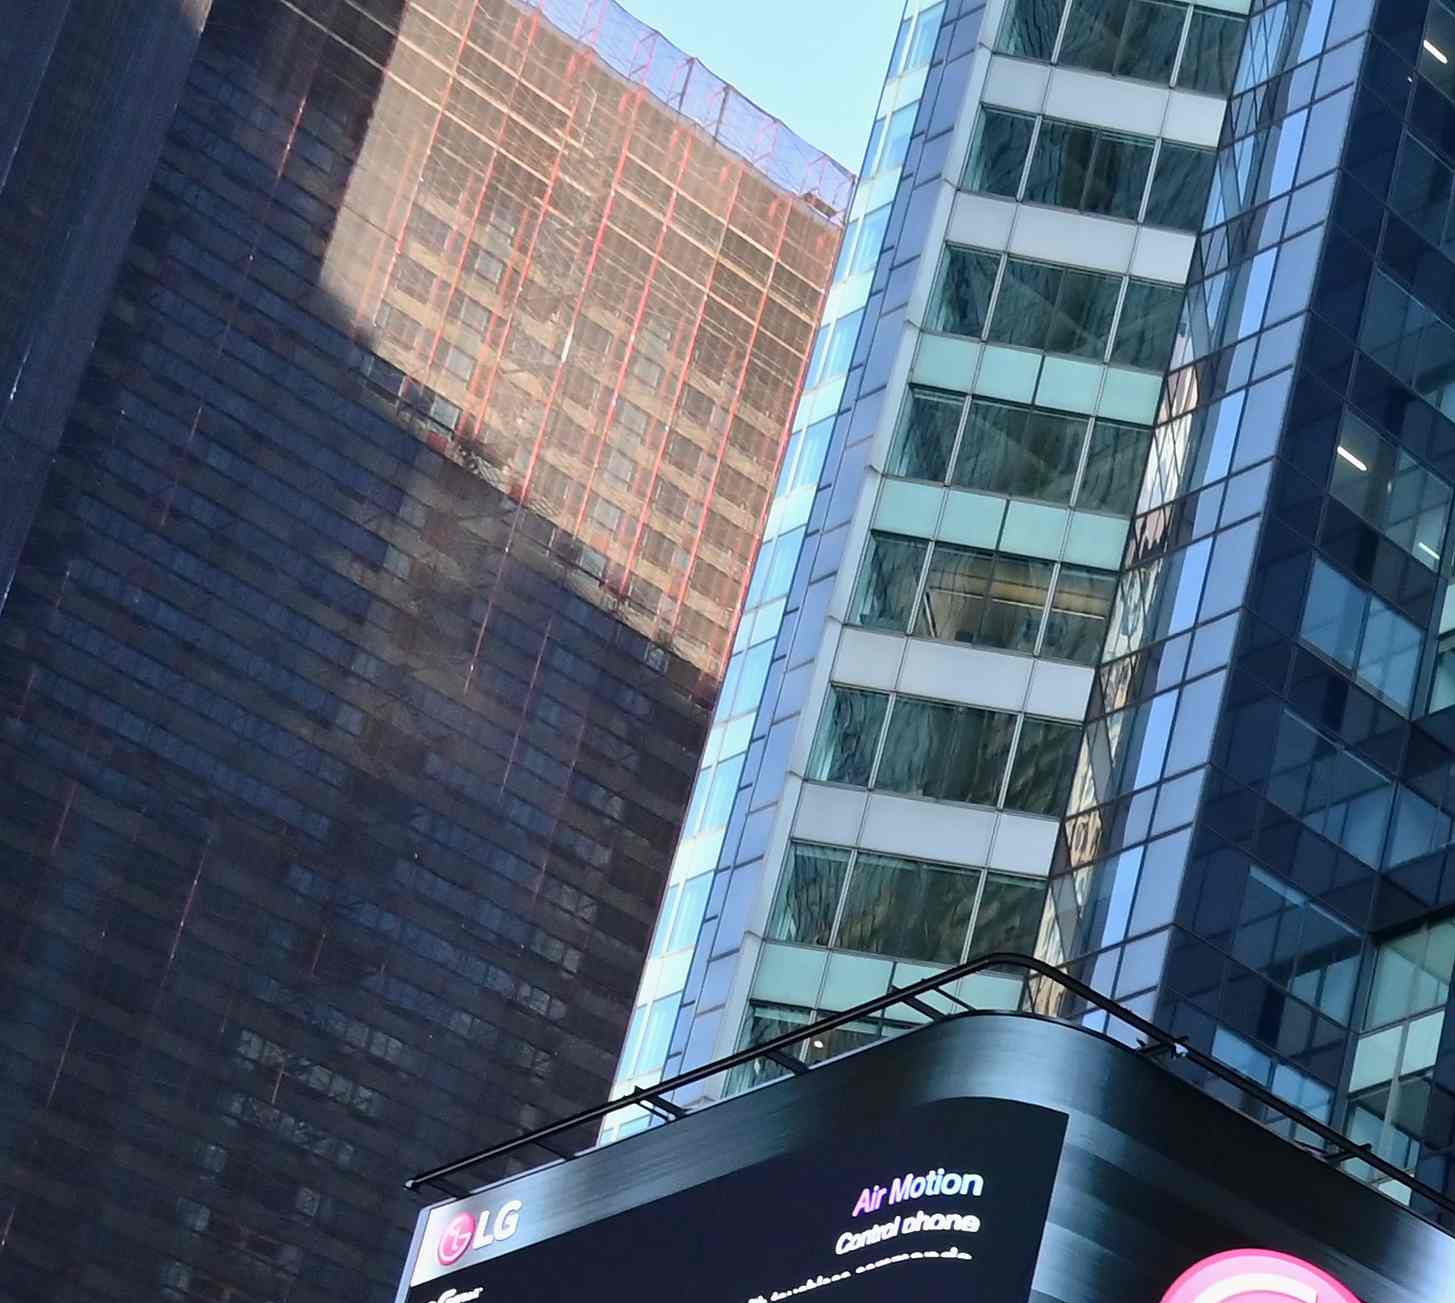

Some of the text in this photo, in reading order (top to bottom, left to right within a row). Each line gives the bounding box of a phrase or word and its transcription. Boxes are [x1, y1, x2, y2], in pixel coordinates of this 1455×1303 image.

[852, 1168, 983, 1217] Air Motion
[473, 1200, 522, 1250] LG
[836, 1216, 900, 1254] Control
